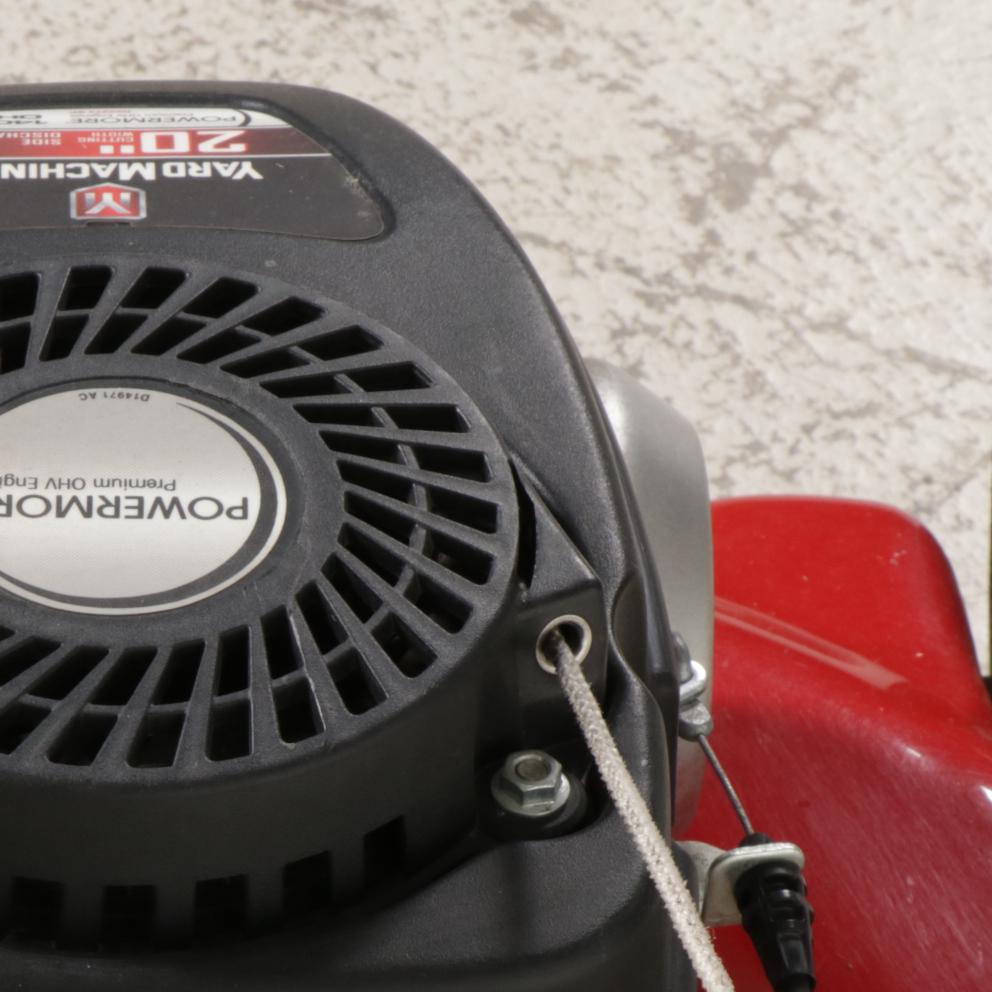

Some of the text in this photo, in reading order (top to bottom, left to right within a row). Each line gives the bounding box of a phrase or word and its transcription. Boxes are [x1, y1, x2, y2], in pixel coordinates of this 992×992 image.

[22, 138, 61, 146] SIDE
[162, 162, 264, 180] YARD
[79, 391, 100, 402] AC
[45, 476, 86, 490] OHV
[93, 477, 176, 491] Premium
